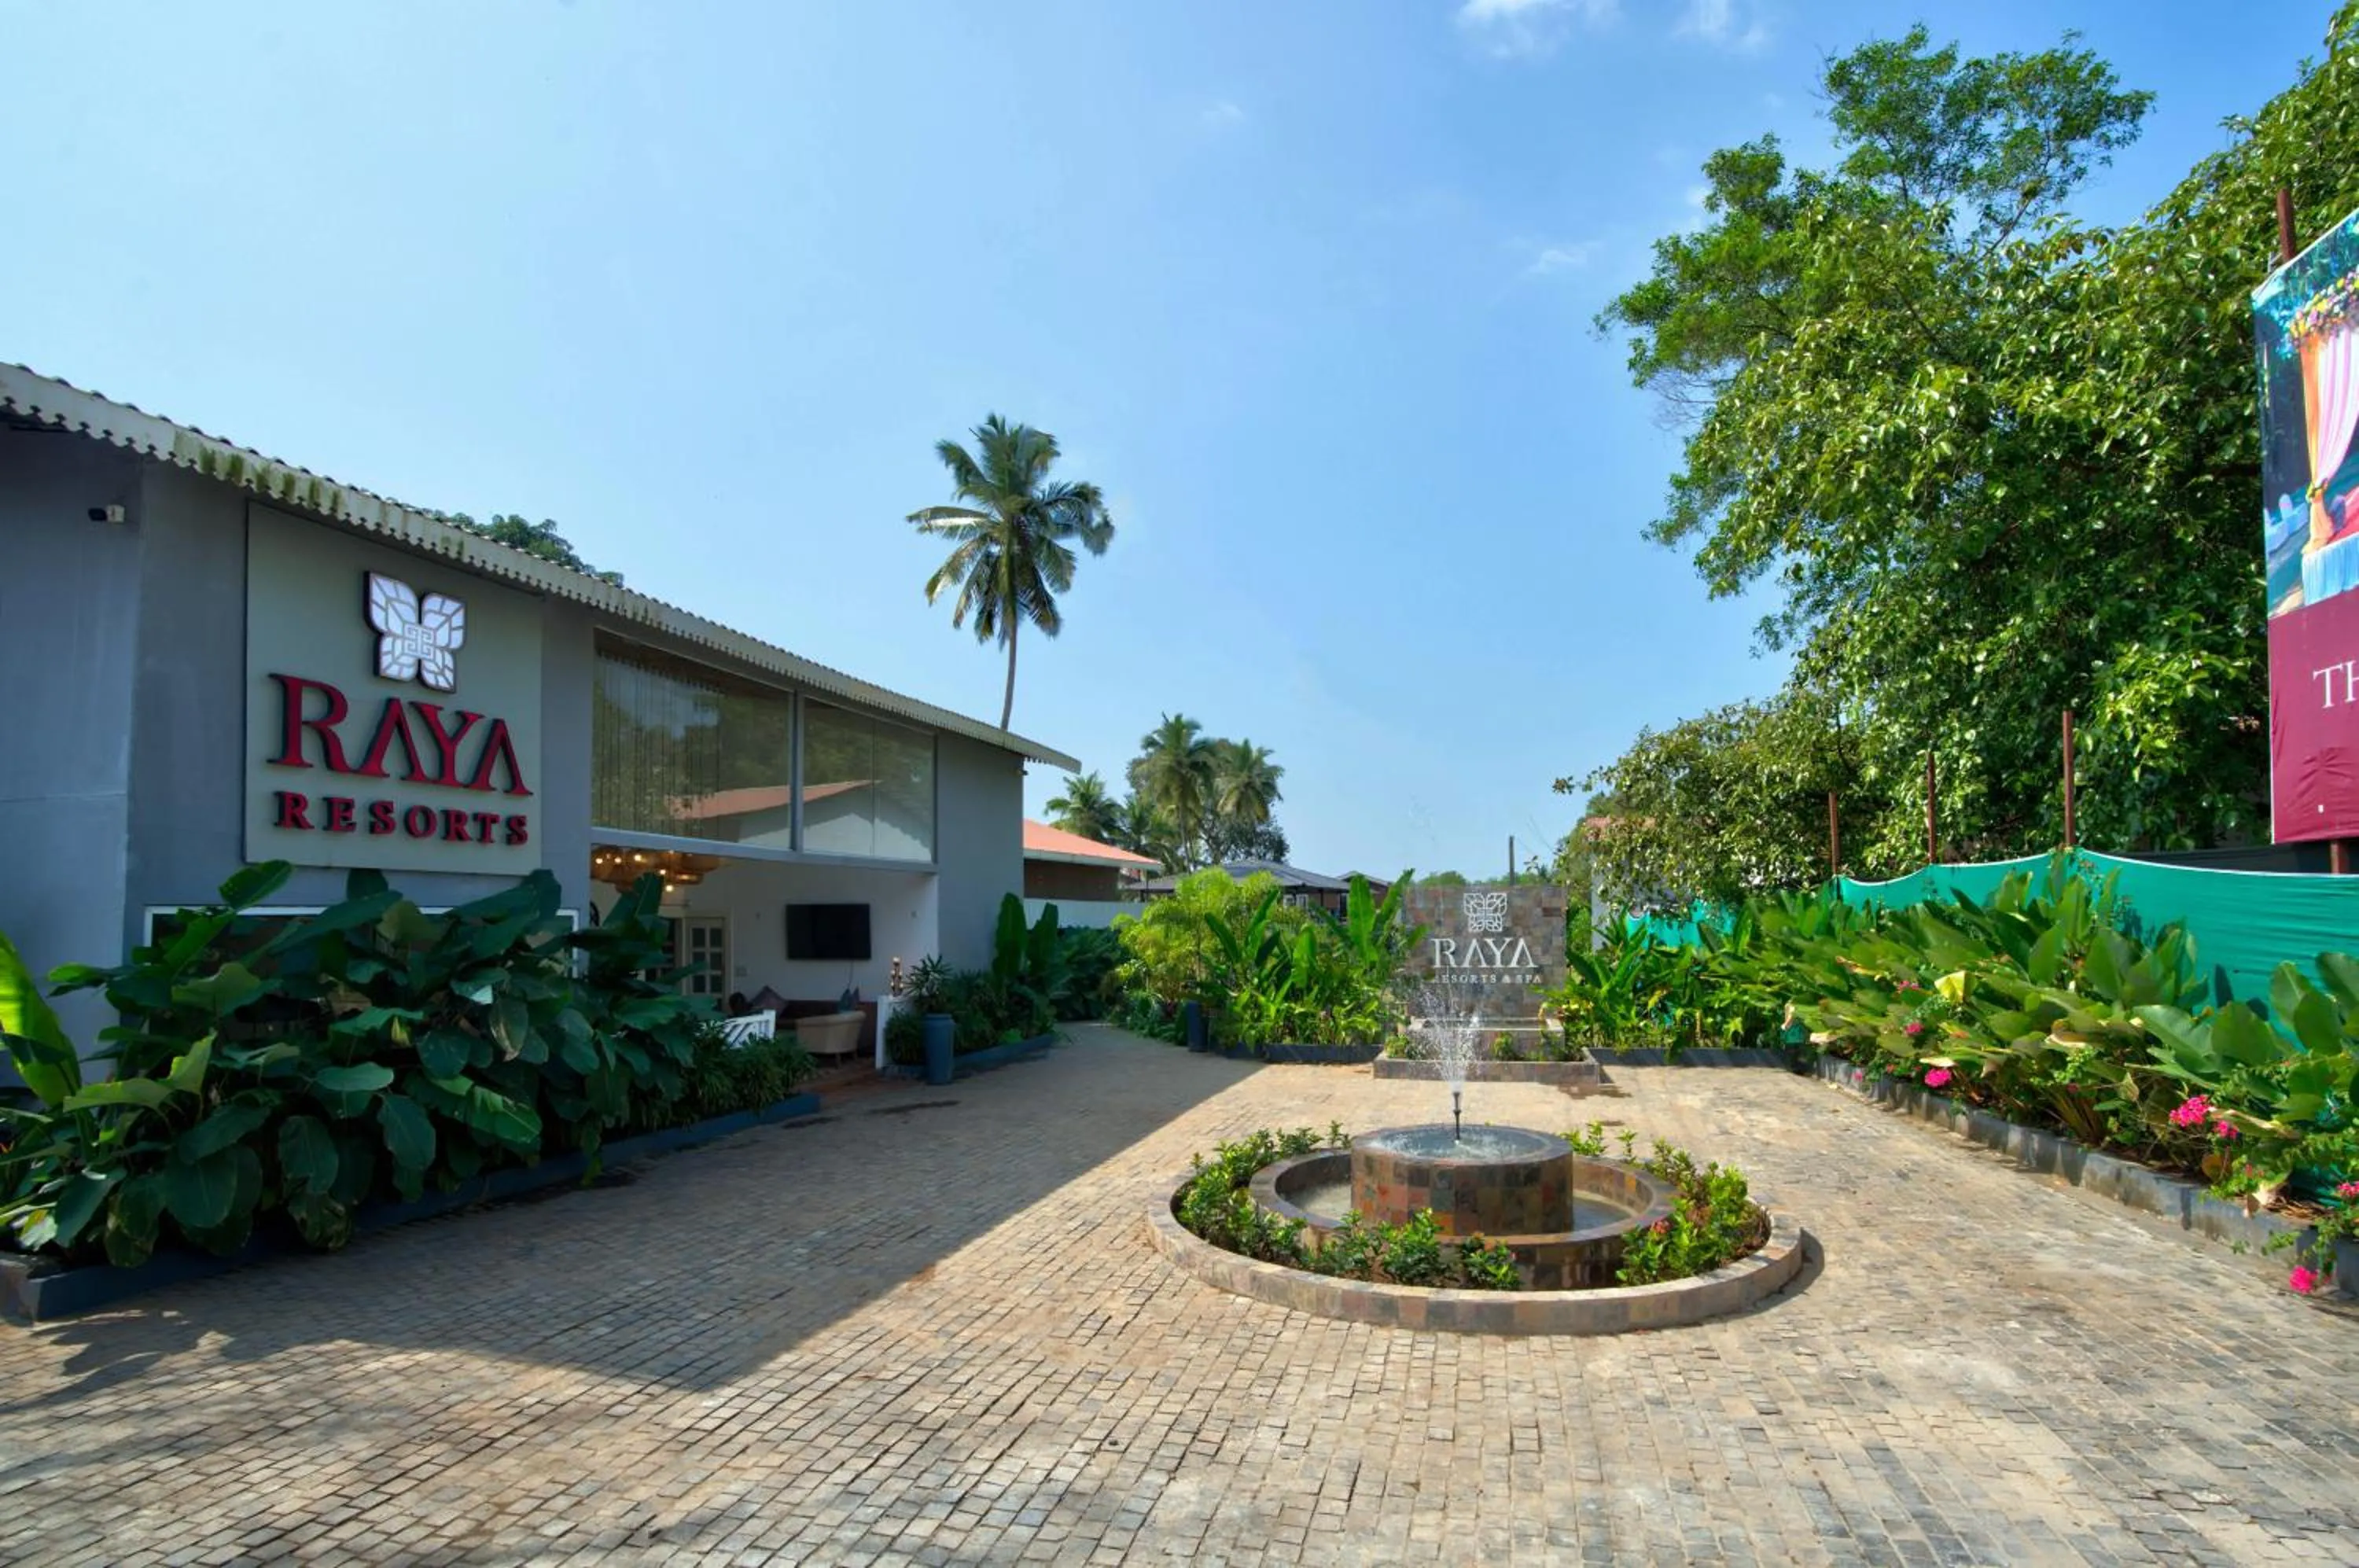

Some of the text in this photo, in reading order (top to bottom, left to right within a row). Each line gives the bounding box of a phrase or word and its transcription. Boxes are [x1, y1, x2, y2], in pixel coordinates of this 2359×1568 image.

[267, 673, 534, 796] RAYA
[274, 791, 530, 846] RESORTS
[1430, 937, 1539, 968] RAYA
